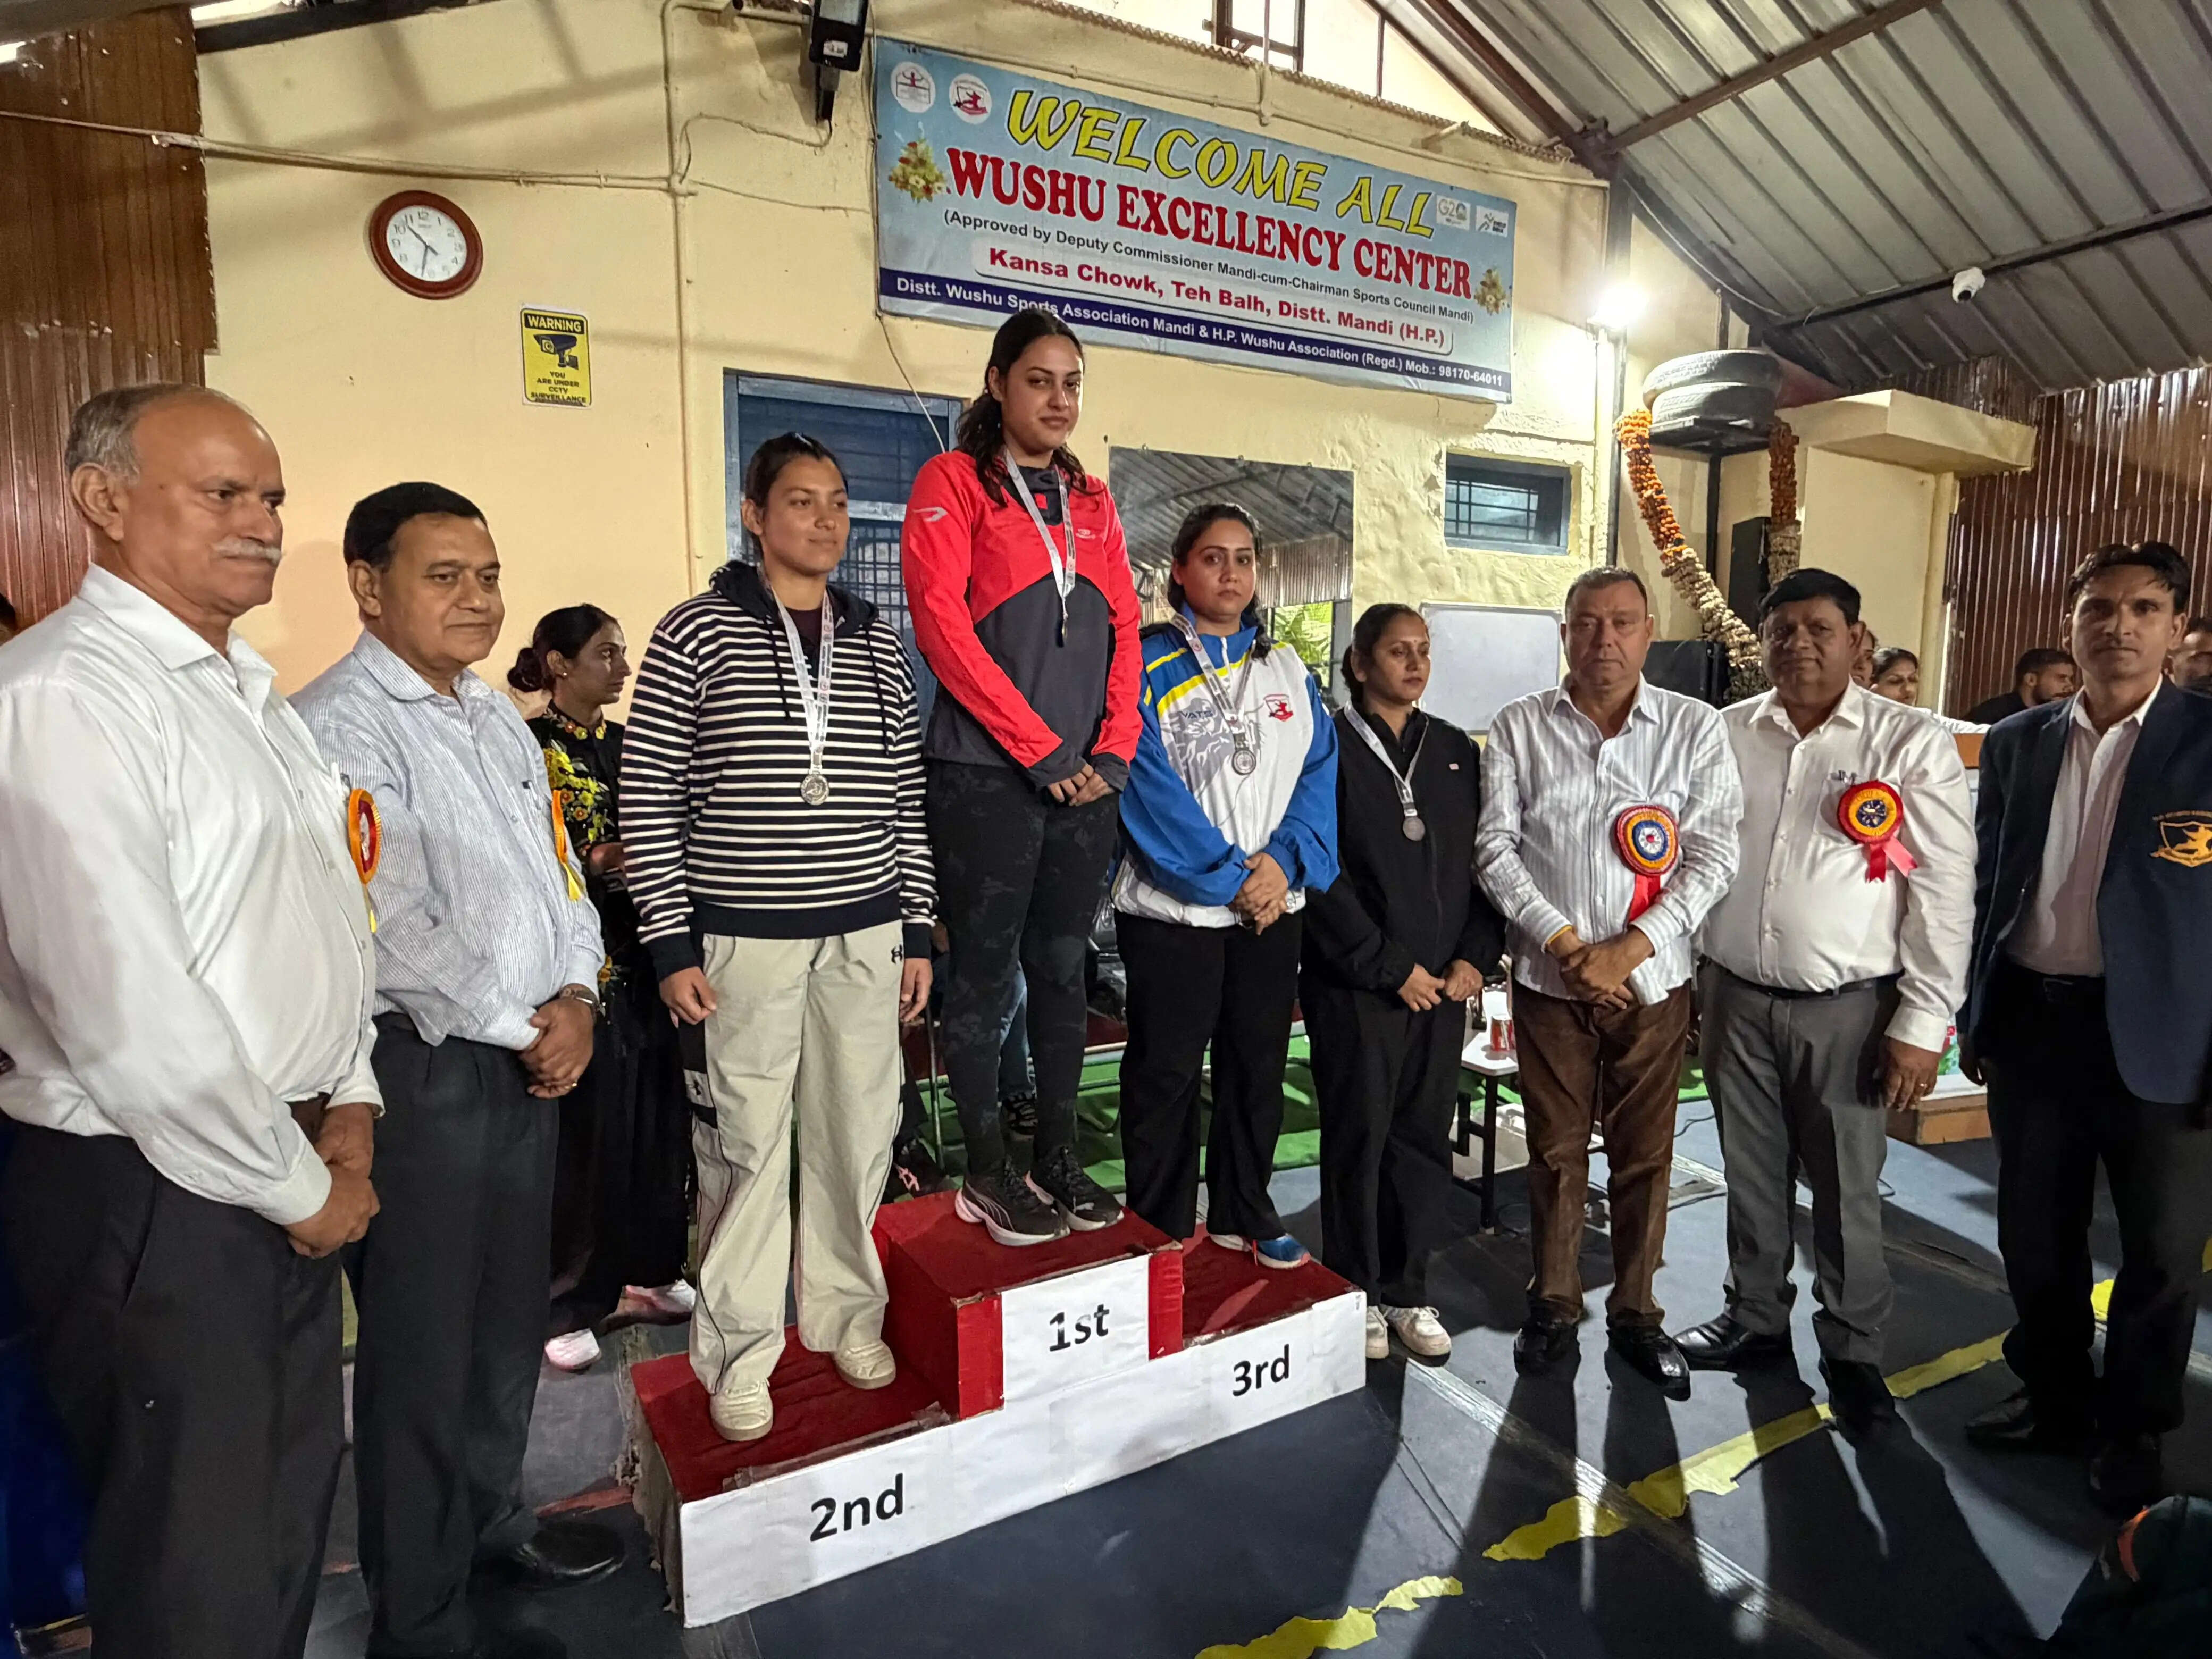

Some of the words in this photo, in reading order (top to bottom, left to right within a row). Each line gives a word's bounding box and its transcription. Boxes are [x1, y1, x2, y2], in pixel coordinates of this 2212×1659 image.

[1008, 90, 1328, 211] WELCOME
[1336, 177, 1435, 239] ALL
[946, 148, 1107, 222] WUSHU
[1117, 184, 1346, 271] EXCELLENCY
[1353, 238, 1471, 299] CENTER
[944, 209, 1028, 237] (Approved
[1033, 221, 1051, 243] by
[1057, 231, 1109, 254] Deputy
[1113, 241, 1213, 272] Commissioner
[1218, 261, 1349, 298] Mandi-cum-Chairman
[1353, 289, 1390, 306] Sports
[1394, 297, 1435, 316] Council
[1438, 306, 1473, 324] Mandi)
[990, 248, 1068, 278] Kansa
[1077, 263, 1163, 298] Chowk,
[1171, 281, 1211, 303] Teh
[1219, 292, 1271, 316] Balh,
[1278, 300, 1330, 325] Distt.
[1338, 311, 1393, 336] Mandi
[1400, 322, 1444, 347] (H.P.)
[527, 315, 582, 332] WARNING
[896, 278, 941, 297] Distt.
[946, 284, 1003, 306] Wushu
[1063, 303, 1149, 329] Association
[1153, 319, 1195, 337] Mandi
[1199, 327, 1209, 338] &
[1213, 328, 1237, 343] H.P.
[1241, 332, 1285, 351] Wushu
[1288, 339, 1359, 362] Association
[1362, 352, 1403, 372] (Regd.)
[1405, 360, 1435, 376] Mob.:
[1438, 365, 1502, 387] 98170-64011
[531, 392, 586, 403] SURVEILLANCE
[554, 379, 579, 387] UNDER
[1048, 1302, 1110, 1352] 1st
[1231, 1345, 1291, 1397] 3rd
[809, 1473, 904, 1542] 2nd
